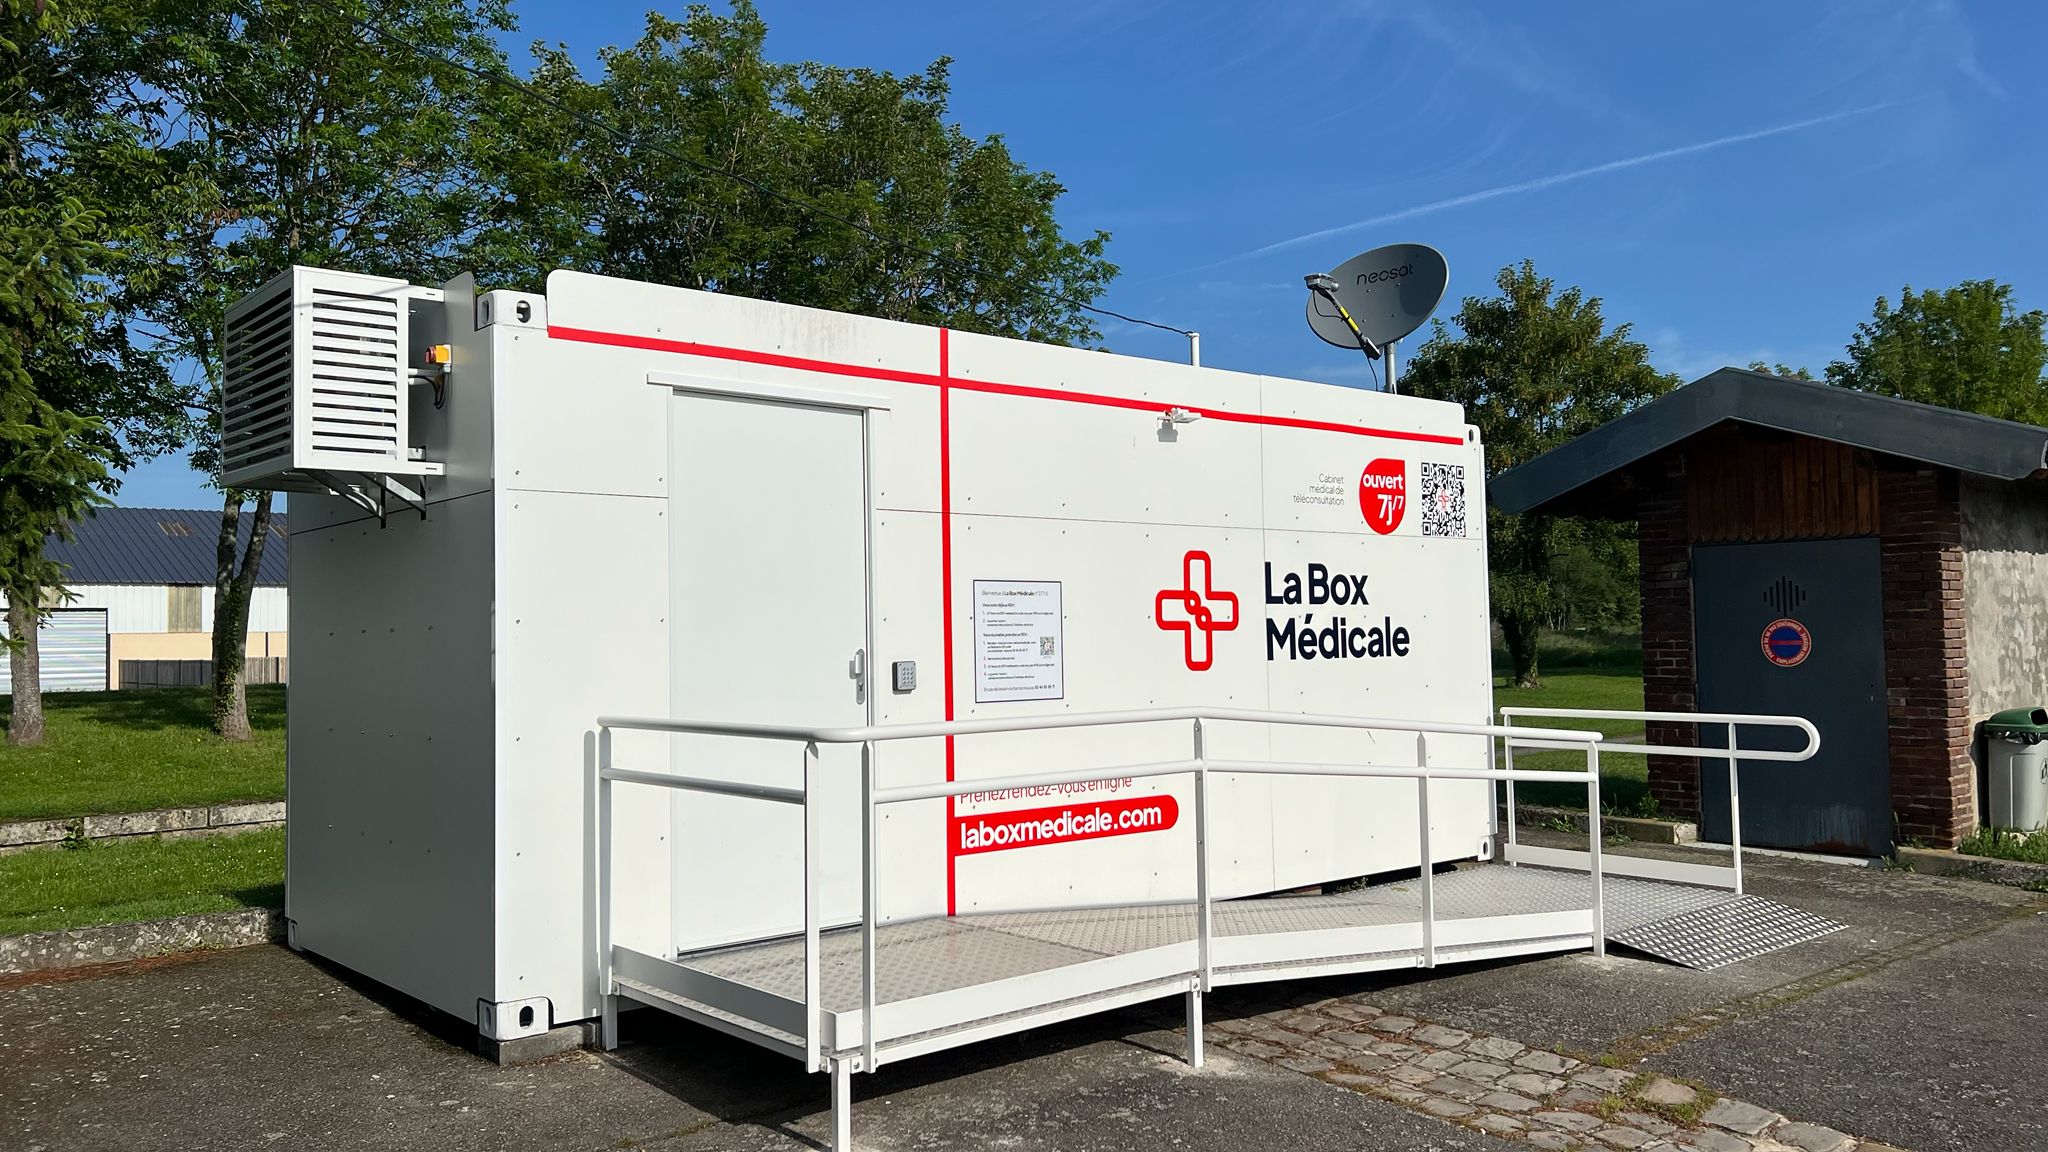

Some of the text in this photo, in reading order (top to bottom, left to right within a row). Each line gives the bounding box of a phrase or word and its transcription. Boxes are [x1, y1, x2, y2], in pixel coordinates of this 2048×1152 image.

[1356, 263, 1414, 286] neosat
[1309, 484, 1345, 495] médical de
[1318, 473, 1345, 485] Cabinet
[1362, 473, 1404, 490] ouvert
[1292, 494, 1345, 506] téléconsultation
[1377, 494, 1404, 526] 7j/7
[1264, 561, 1369, 606] La Box
[1265, 613, 1410, 661] Médicale
[961, 806, 1162, 850] laboxmedicale.com
